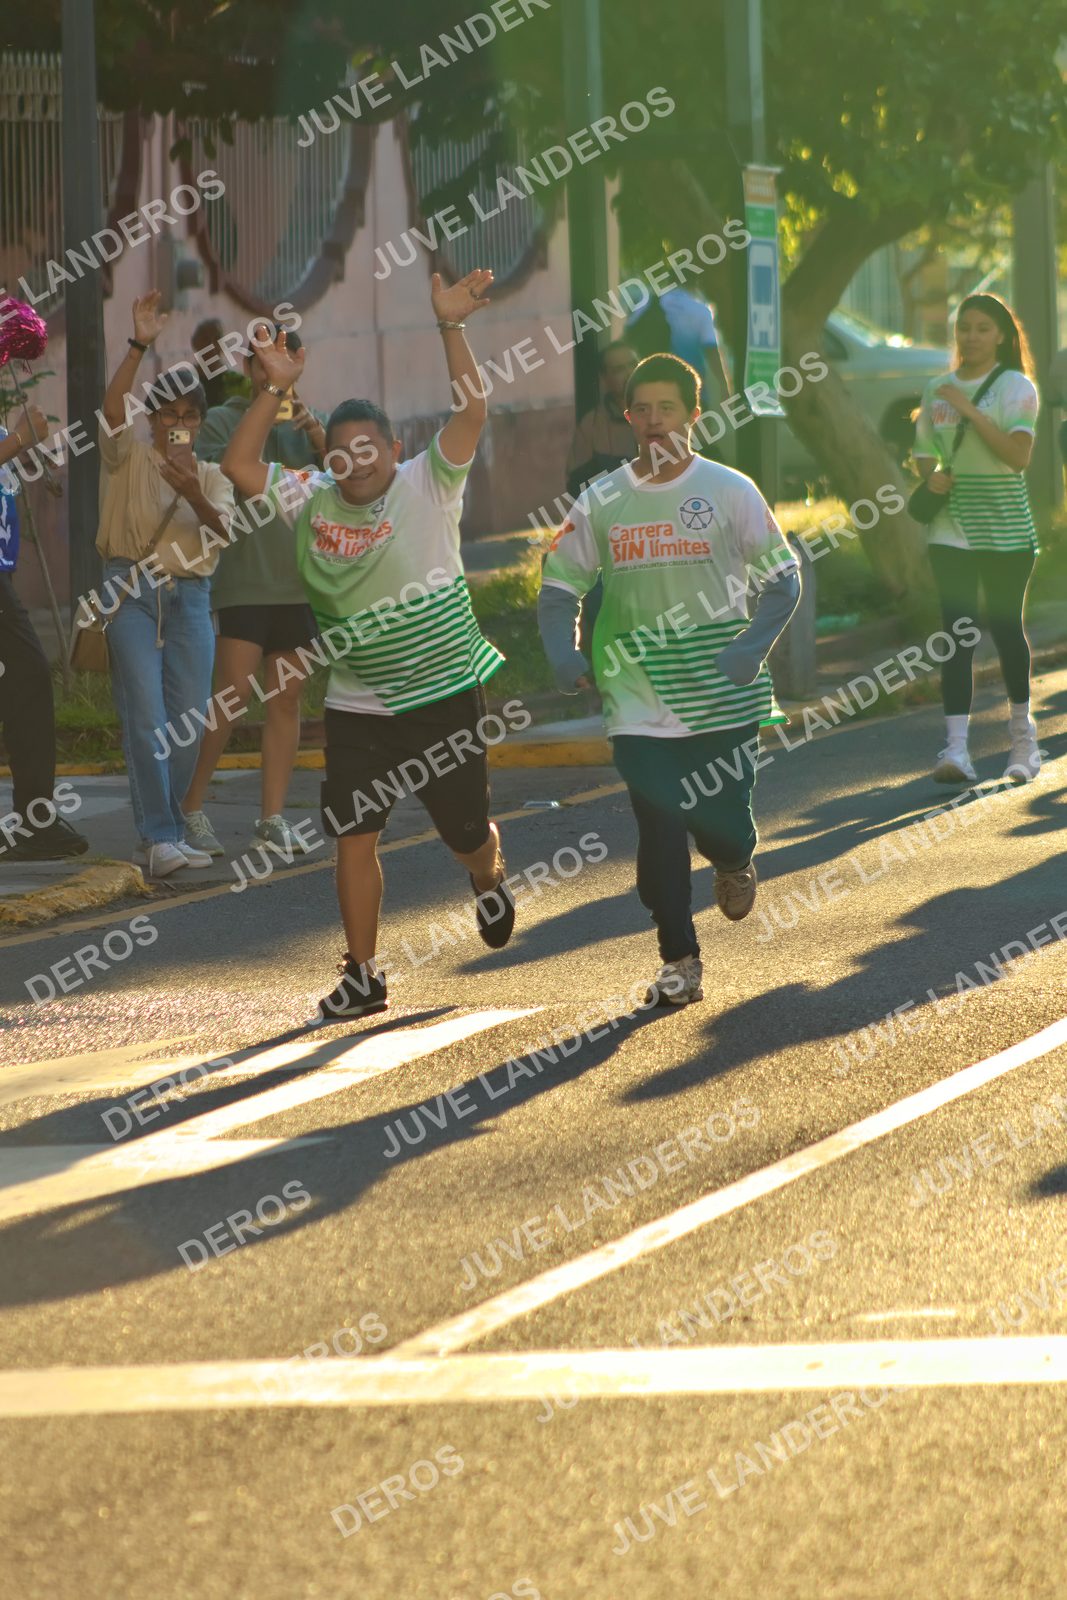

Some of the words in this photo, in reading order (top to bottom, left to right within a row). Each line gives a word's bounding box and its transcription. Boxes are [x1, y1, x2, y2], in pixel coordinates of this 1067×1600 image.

[608, 523, 673, 543] Carrera
[613, 540, 645, 563] SIN
[650, 539, 711, 558] límites
